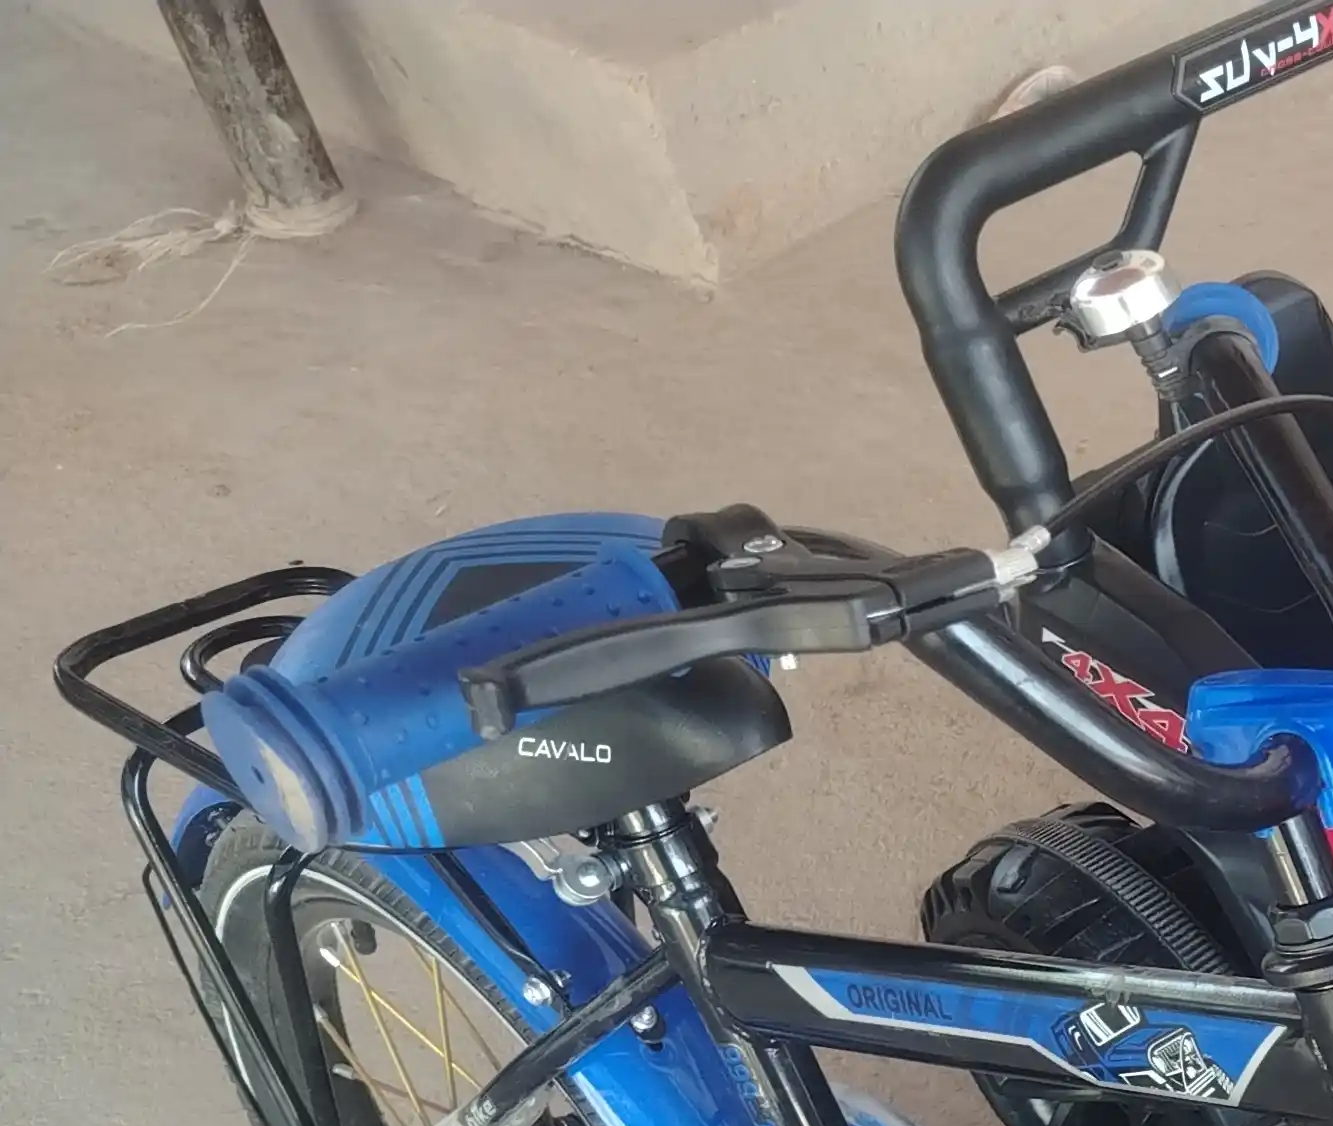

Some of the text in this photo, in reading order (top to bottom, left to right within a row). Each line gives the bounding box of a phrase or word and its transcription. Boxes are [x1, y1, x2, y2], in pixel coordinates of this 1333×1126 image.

[1061, 651, 1188, 754] 4X4
[518, 737, 612, 764] CAVALO
[846, 983, 953, 1021] ORIGINAL
